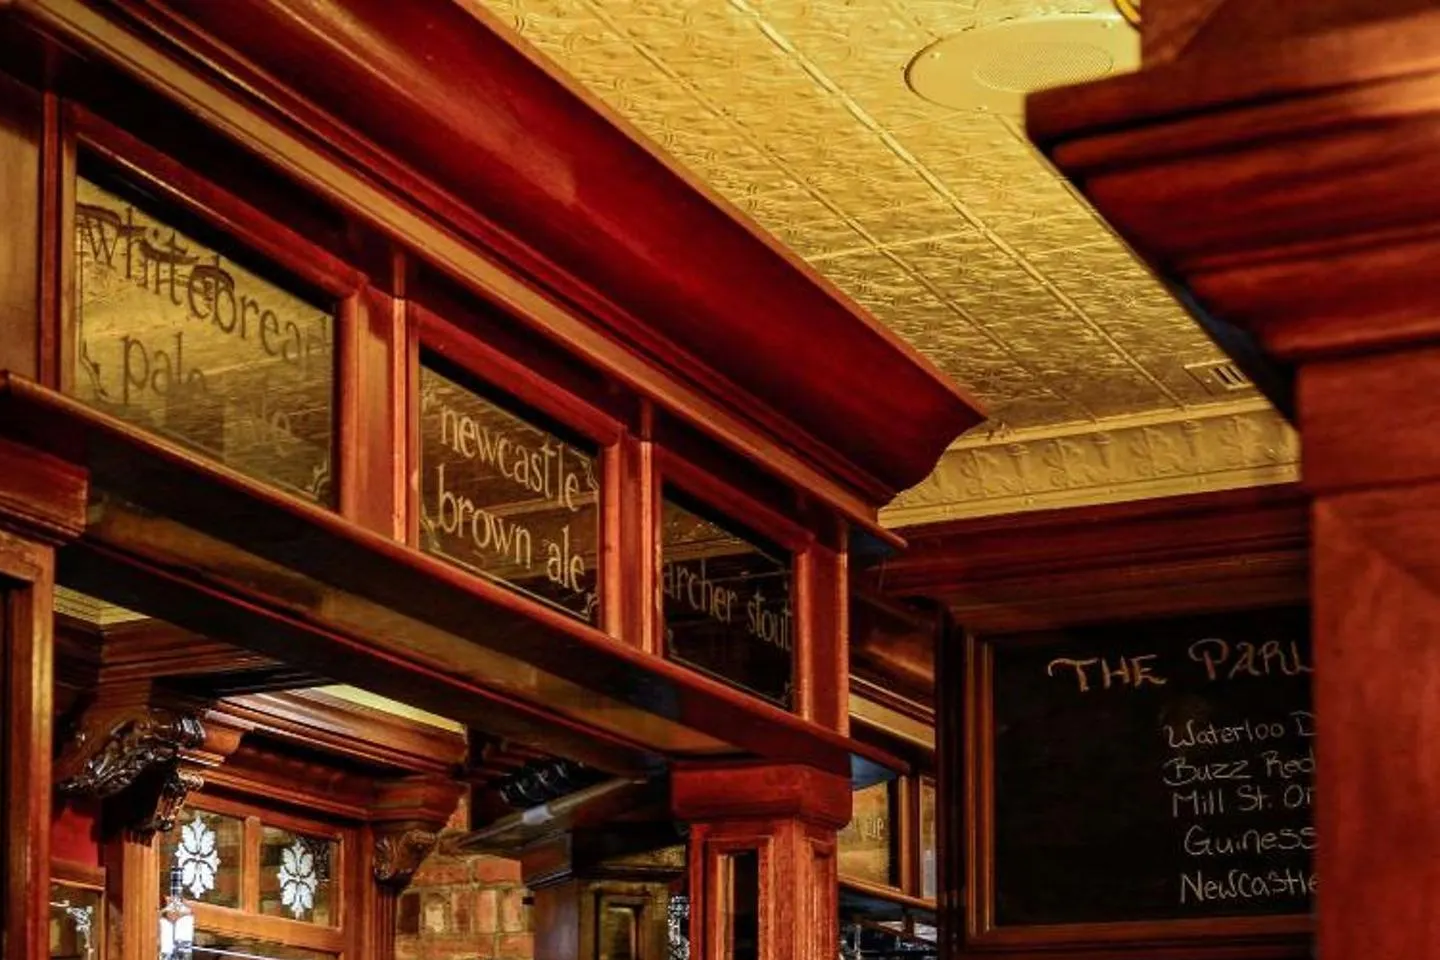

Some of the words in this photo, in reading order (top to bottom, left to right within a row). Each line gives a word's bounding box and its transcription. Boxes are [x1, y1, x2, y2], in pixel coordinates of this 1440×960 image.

[440, 405, 580, 512] newcastle
[437, 464, 531, 569] brown
[546, 527, 585, 592] ale
[747, 590, 792, 651] stout
[1047, 653, 1167, 693] THE
[1162, 719, 1284, 748] Waterloo
[1162, 756, 1252, 786] Buzz
[1172, 788, 1224, 818] Mill
